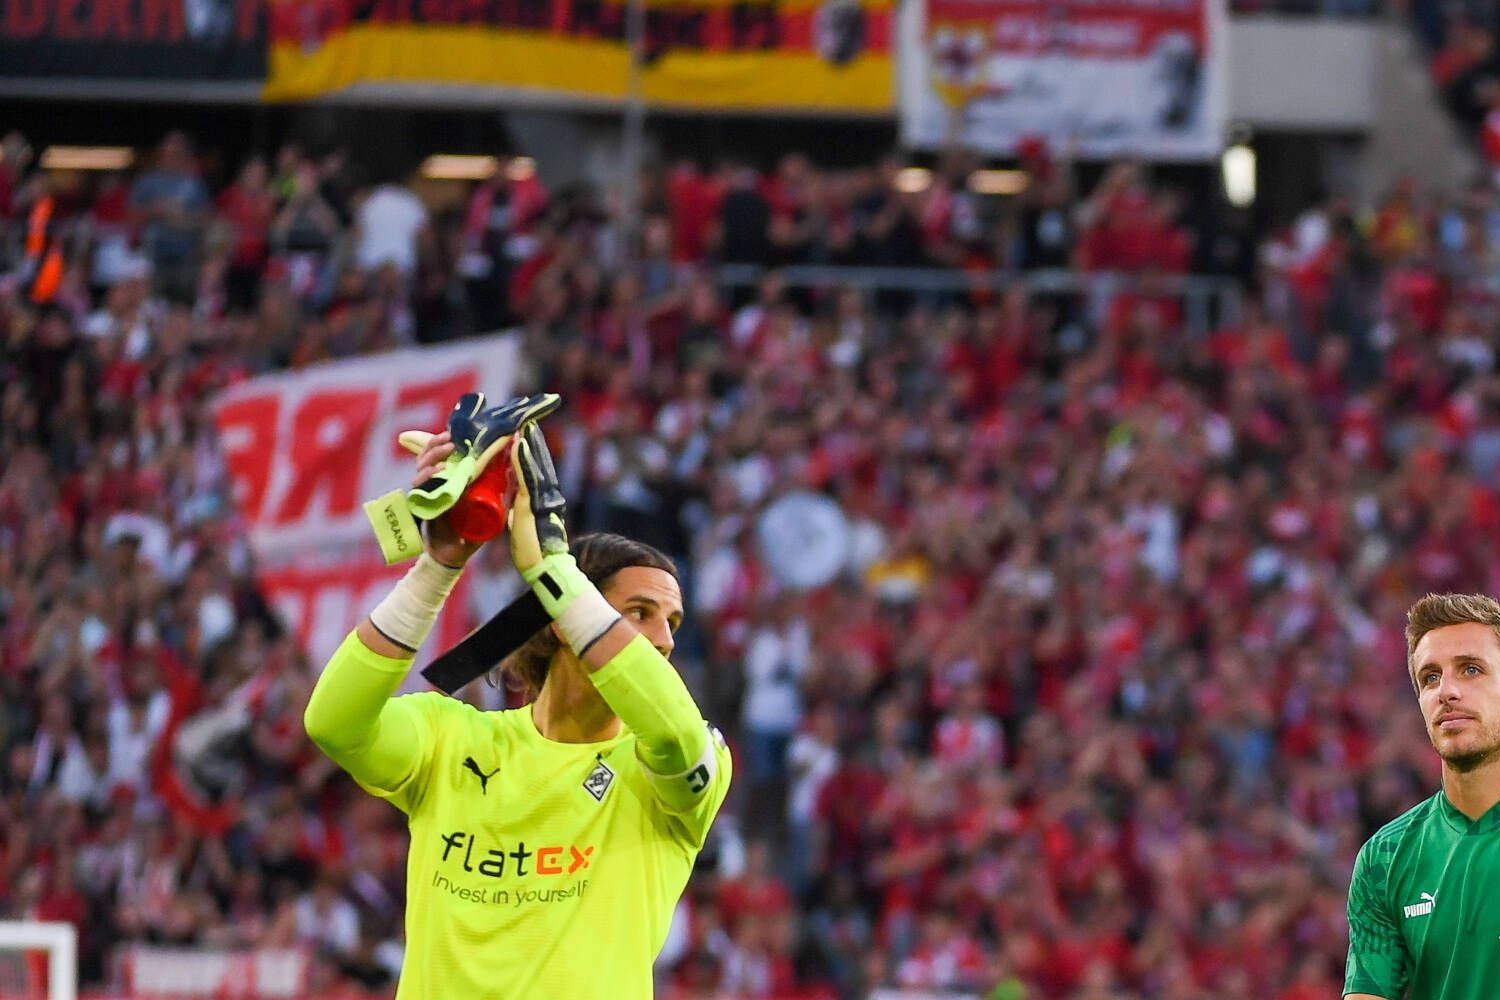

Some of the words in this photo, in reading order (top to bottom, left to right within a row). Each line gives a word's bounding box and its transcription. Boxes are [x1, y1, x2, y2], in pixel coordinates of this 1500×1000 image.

[383, 504, 407, 552] VERANO
[432, 870, 487, 904] Invest
[492, 890, 509, 904] in
[1404, 902, 1431, 918] PUMA
